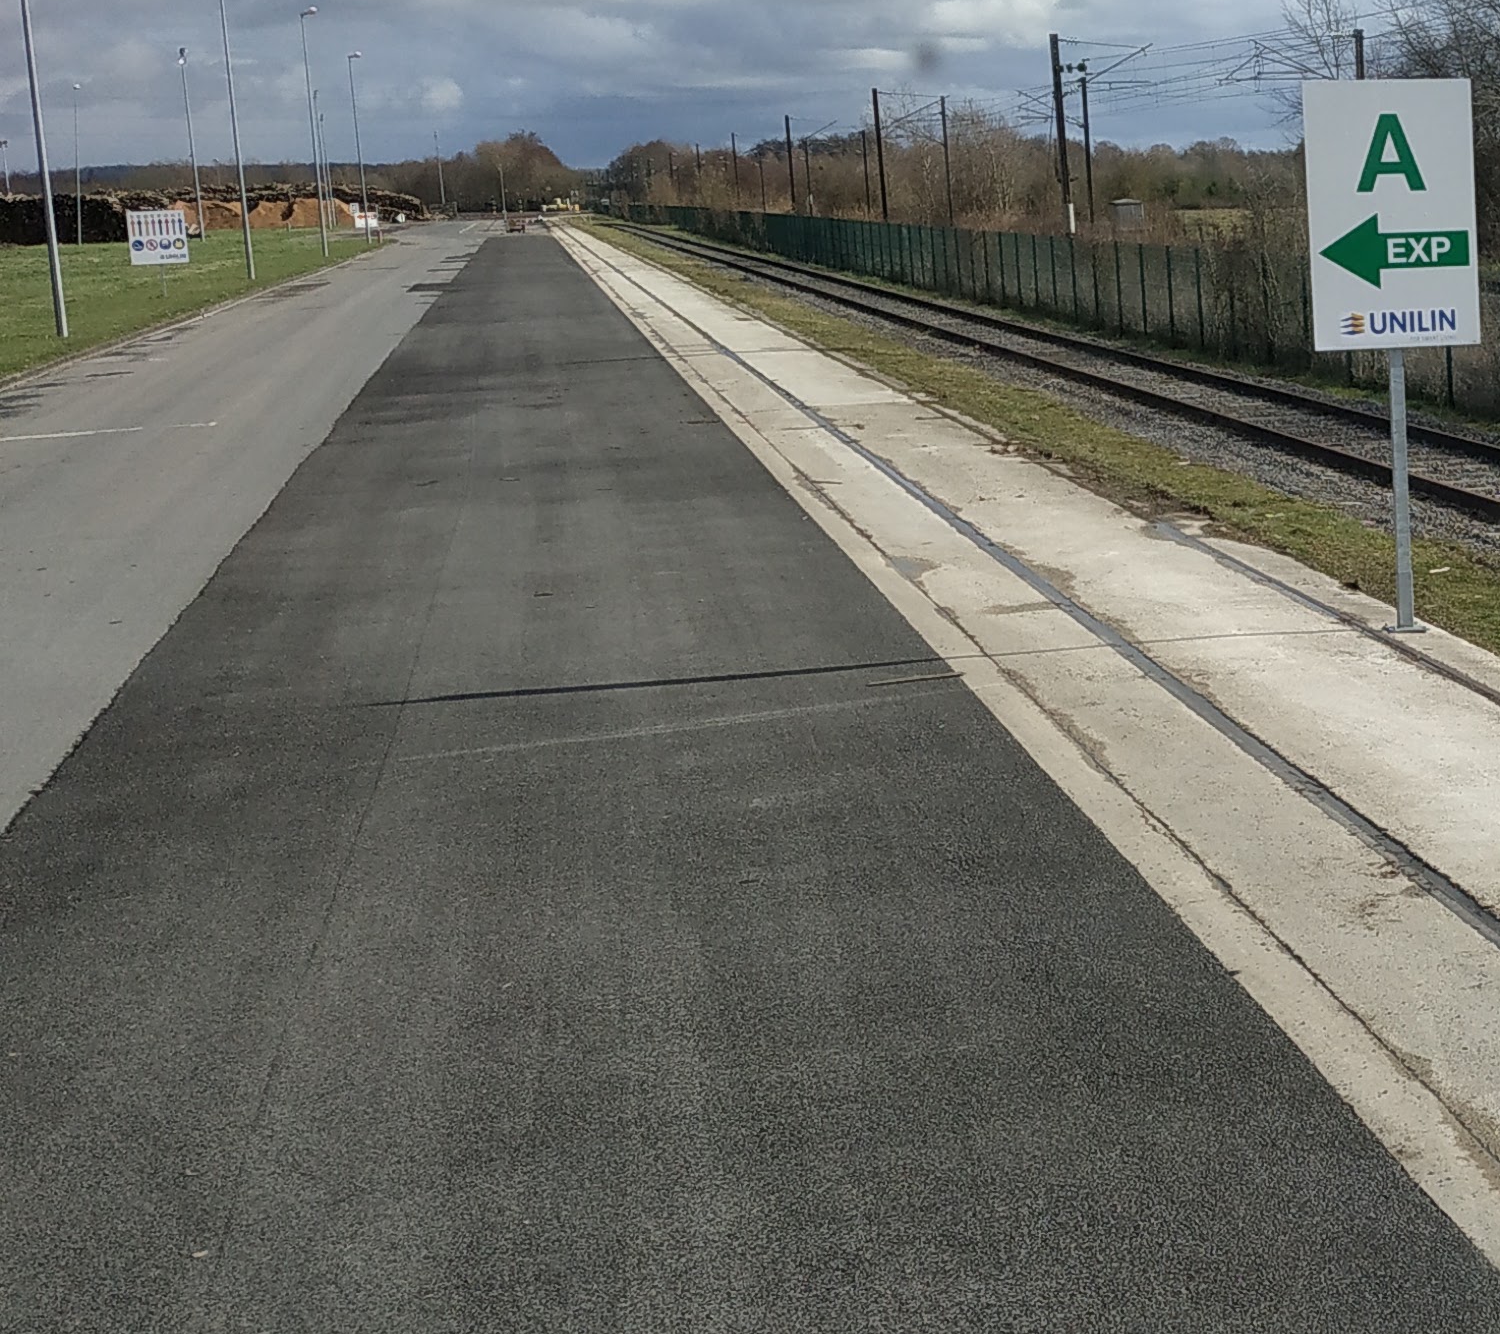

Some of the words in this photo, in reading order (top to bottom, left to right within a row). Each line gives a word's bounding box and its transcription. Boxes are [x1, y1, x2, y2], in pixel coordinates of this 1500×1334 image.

[1357, 113, 1426, 192] A
[1386, 236, 1451, 264] EXP
[1369, 309, 1456, 334] UNILIN
